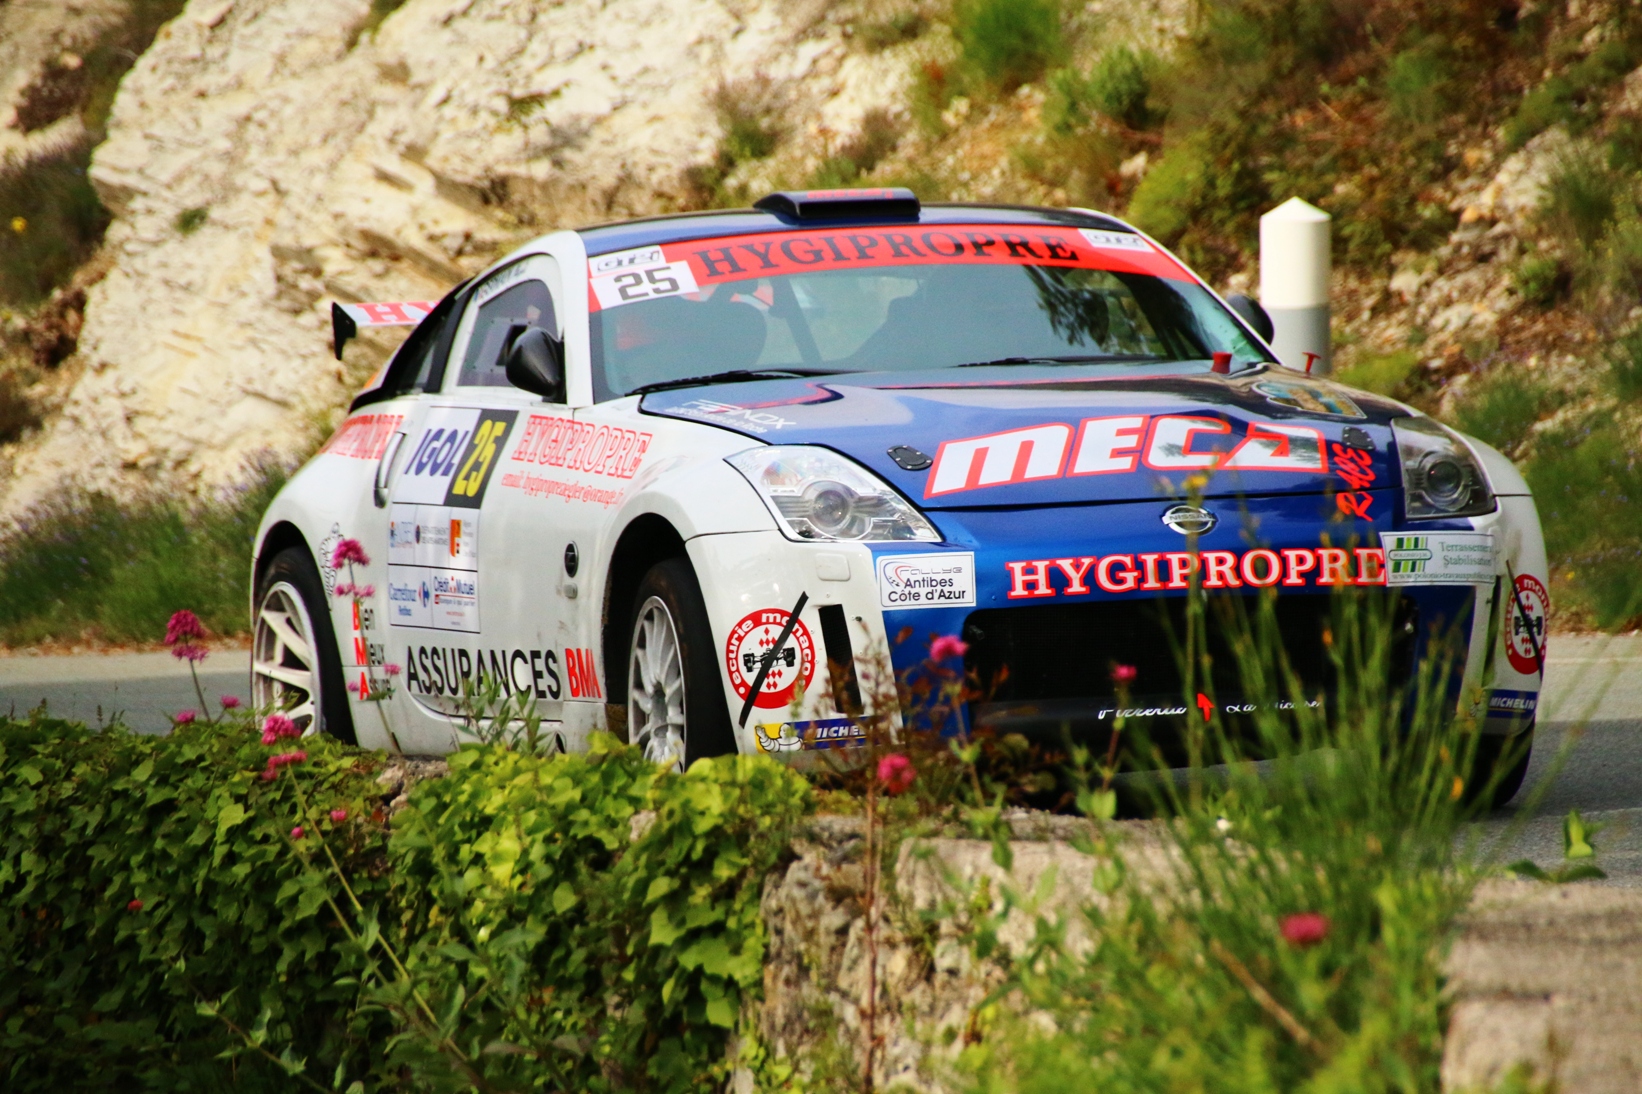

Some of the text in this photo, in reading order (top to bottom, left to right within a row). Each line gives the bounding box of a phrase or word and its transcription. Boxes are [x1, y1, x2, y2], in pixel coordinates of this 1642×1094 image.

[693, 230, 1080, 278] HYGIPROPRE
[613, 266, 681, 301] 25
[403, 427, 469, 477] IGOL
[452, 419, 507, 497] 25
[511, 414, 653, 479] HYGIPROPRE
[924, 413, 1330, 500] MECA
[1331, 442, 1377, 522] RACE
[888, 588, 967, 602] Côte d'Azur
[904, 577, 954, 589] Antibes
[1005, 547, 1387, 600] HYGIPROPRE
[407, 645, 603, 700] ASSURANCES BMA
[728, 619, 755, 685] ecurie
[1489, 696, 1537, 710] MICHELIN
